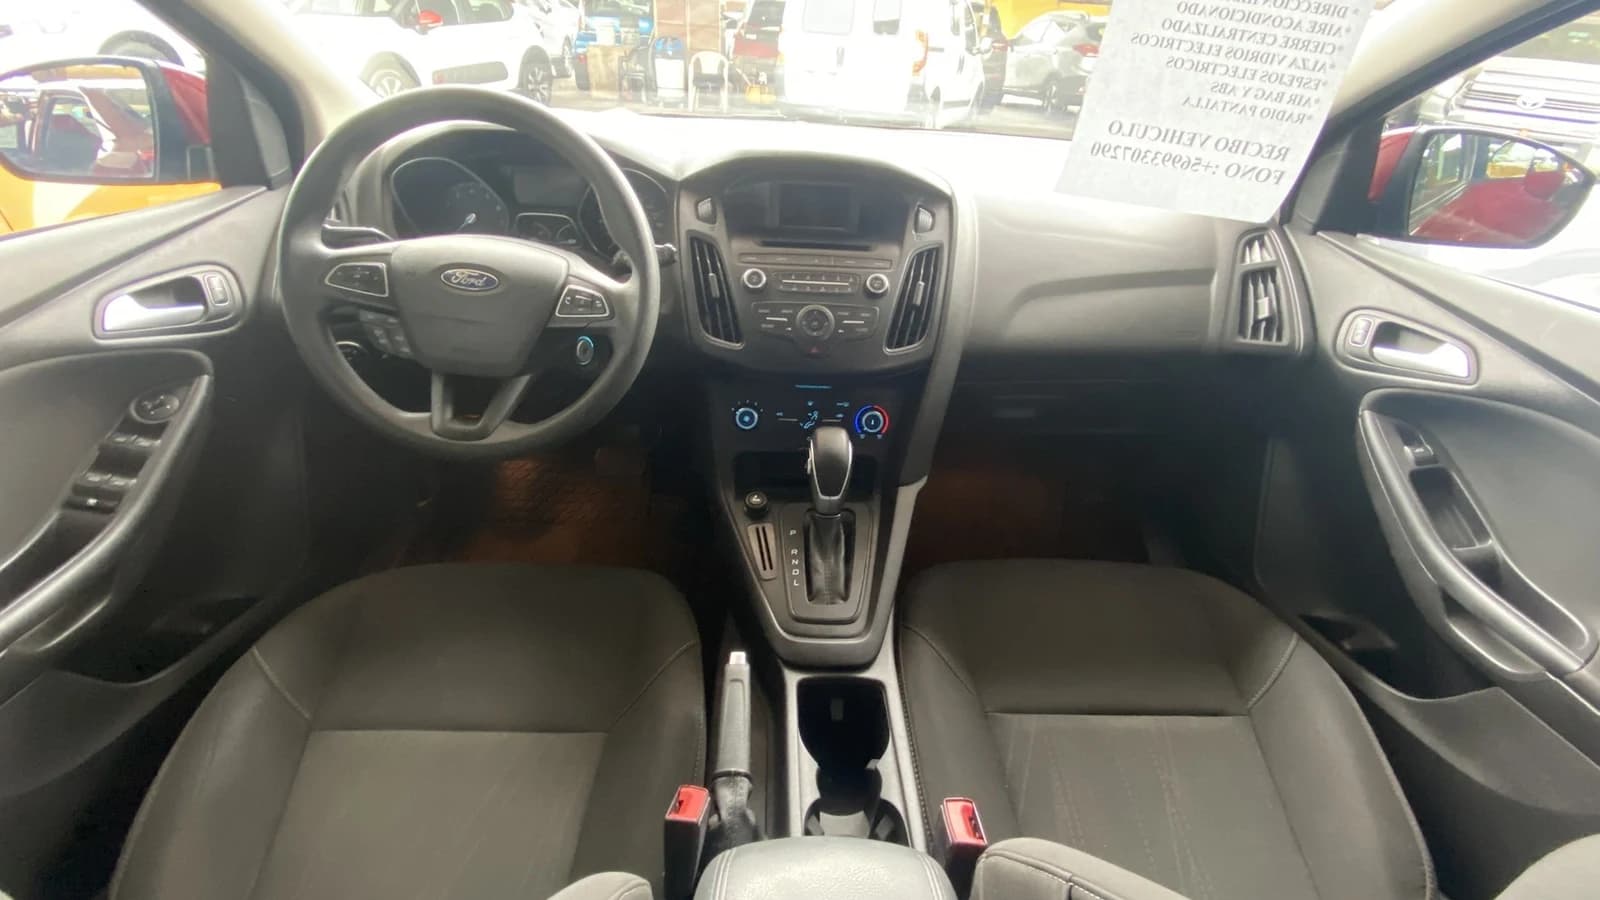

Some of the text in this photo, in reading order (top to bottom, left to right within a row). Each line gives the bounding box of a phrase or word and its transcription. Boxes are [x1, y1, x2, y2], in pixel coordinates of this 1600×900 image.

[451, 271, 488, 286] Ford
[791, 548, 799, 556] R
[791, 558, 799, 566] N
